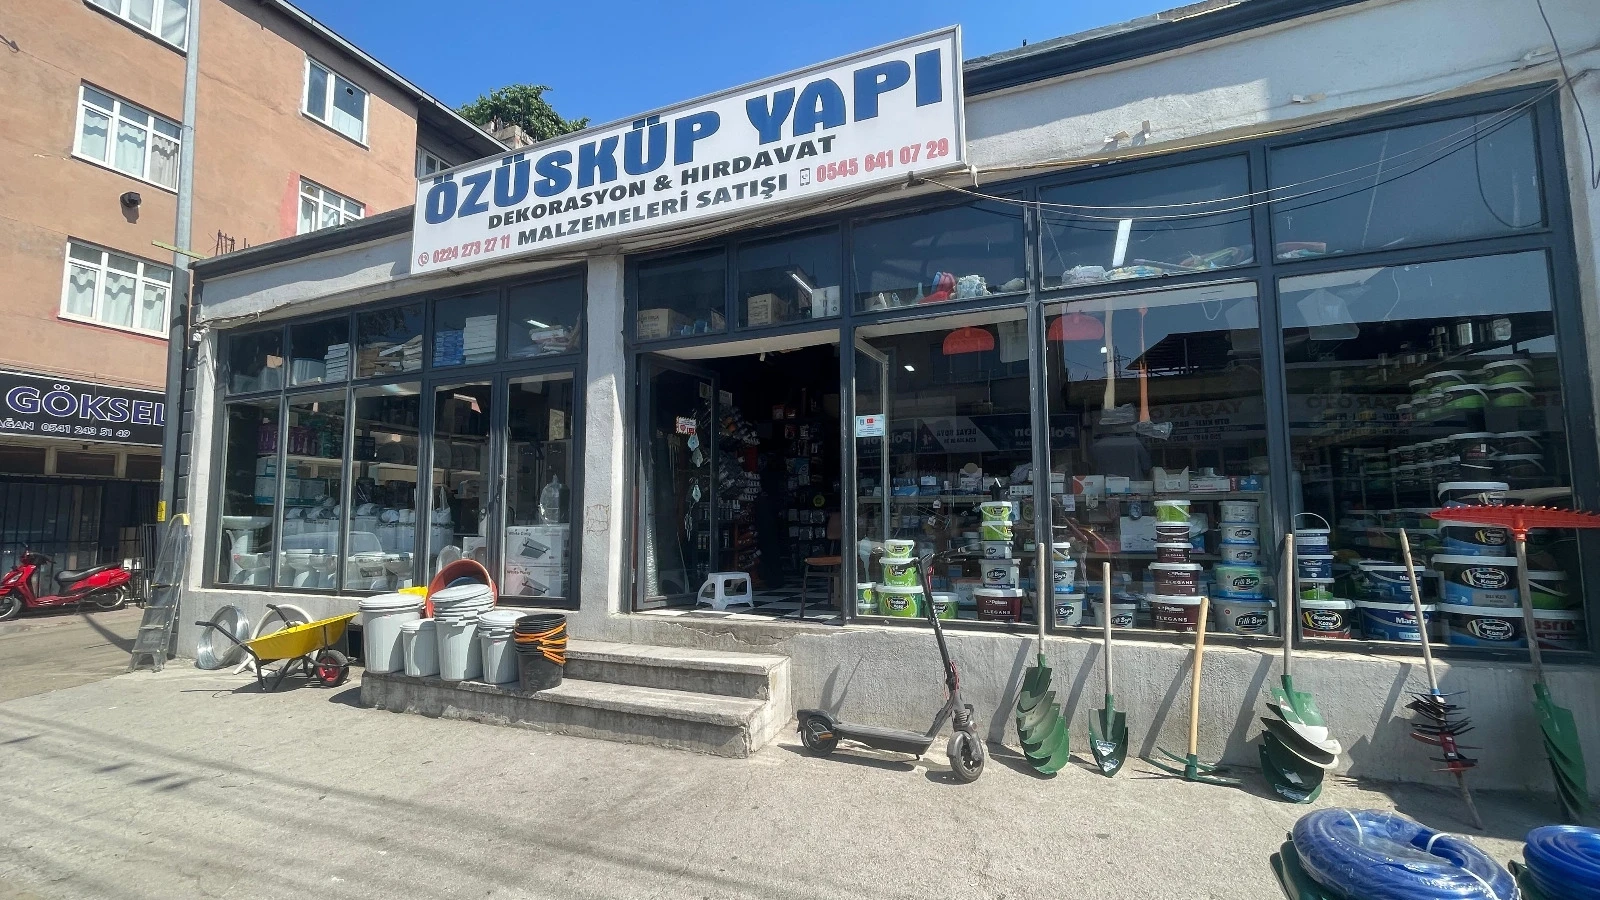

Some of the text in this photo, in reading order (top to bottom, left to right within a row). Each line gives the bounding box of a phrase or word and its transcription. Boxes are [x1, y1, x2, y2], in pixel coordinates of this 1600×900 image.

[425, 48, 942, 225] ÖZÜSKÜP YAPI
[488, 134, 836, 229] DEKORASYON & HIRDAVAT
[816, 137, 949, 182] 0545 641 07 29
[518, 173, 788, 245] MALZEMELERİ SATIŞI
[433, 234, 511, 264] 0224 273 27 11
[5, 383, 165, 427] GÖKSEL
[41, 423, 71, 434] 0541
[74, 425, 97, 435] 243
[100, 427, 113, 436] 51
[116, 428, 131, 438] 49
